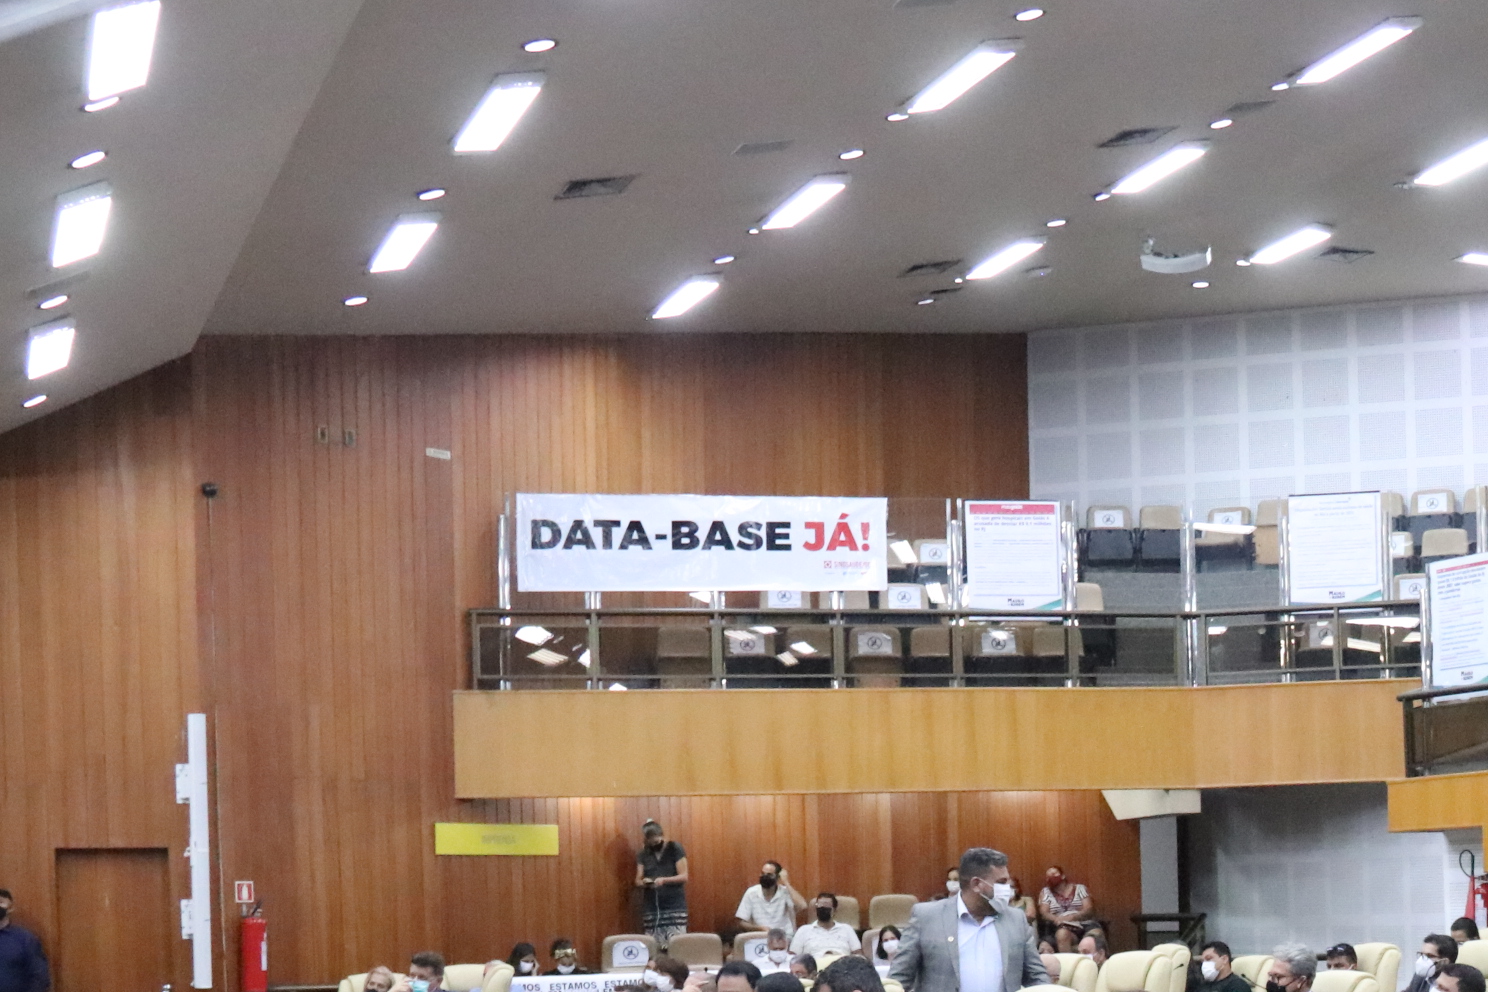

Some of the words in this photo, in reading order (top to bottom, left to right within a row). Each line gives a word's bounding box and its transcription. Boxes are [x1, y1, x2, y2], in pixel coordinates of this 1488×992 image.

[530, 519, 792, 552] DATA-BASE
[803, 512, 870, 552] JÁ!
[550, 982, 597, 990] ESTAMOS
